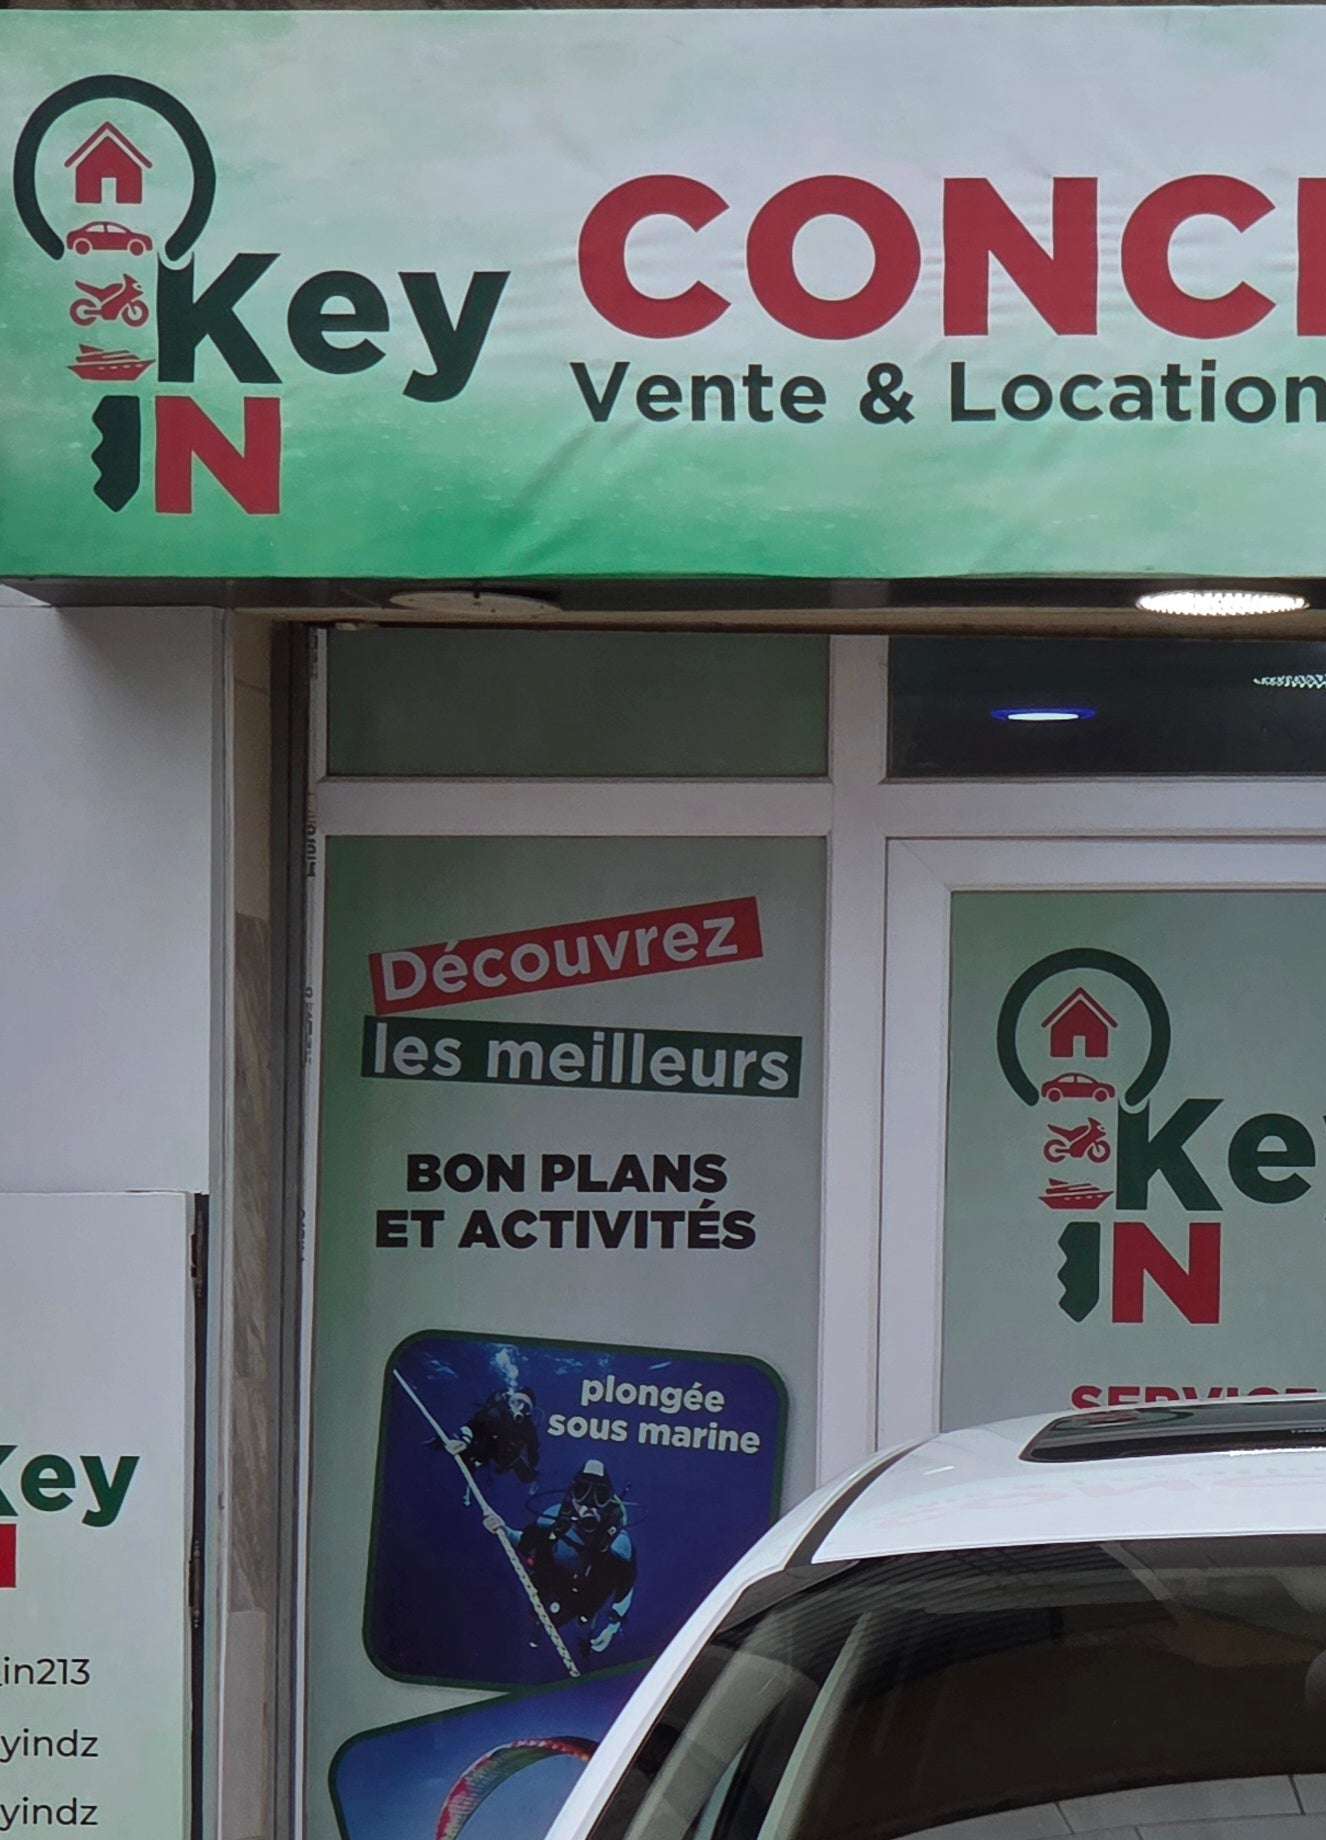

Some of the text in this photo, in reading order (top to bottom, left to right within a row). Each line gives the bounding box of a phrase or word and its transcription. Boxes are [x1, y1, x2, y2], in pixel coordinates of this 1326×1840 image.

[156, 252, 511, 402] Key
[570, 360, 826, 424] Vente
[859, 360, 916, 425] &
[93, 395, 281, 515] IN
[381, 916, 738, 1001] Découvrez
[374, 1022, 462, 1076] les
[486, 1031, 789, 1090] meilleurs
[406, 1153, 728, 1193] BON PLANS
[376, 1199, 756, 1249] ET ACTIVITÉS
[1057, 1221, 1221, 1324] IN
[581, 1375, 725, 1413] plongée
[548, 1410, 760, 1454] sous marine
[0, 1445, 140, 1528] ey
[0, 1657, 90, 1685] in213
[0, 1728, 99, 1763] yindz
[0, 1797, 98, 1831] yindz
